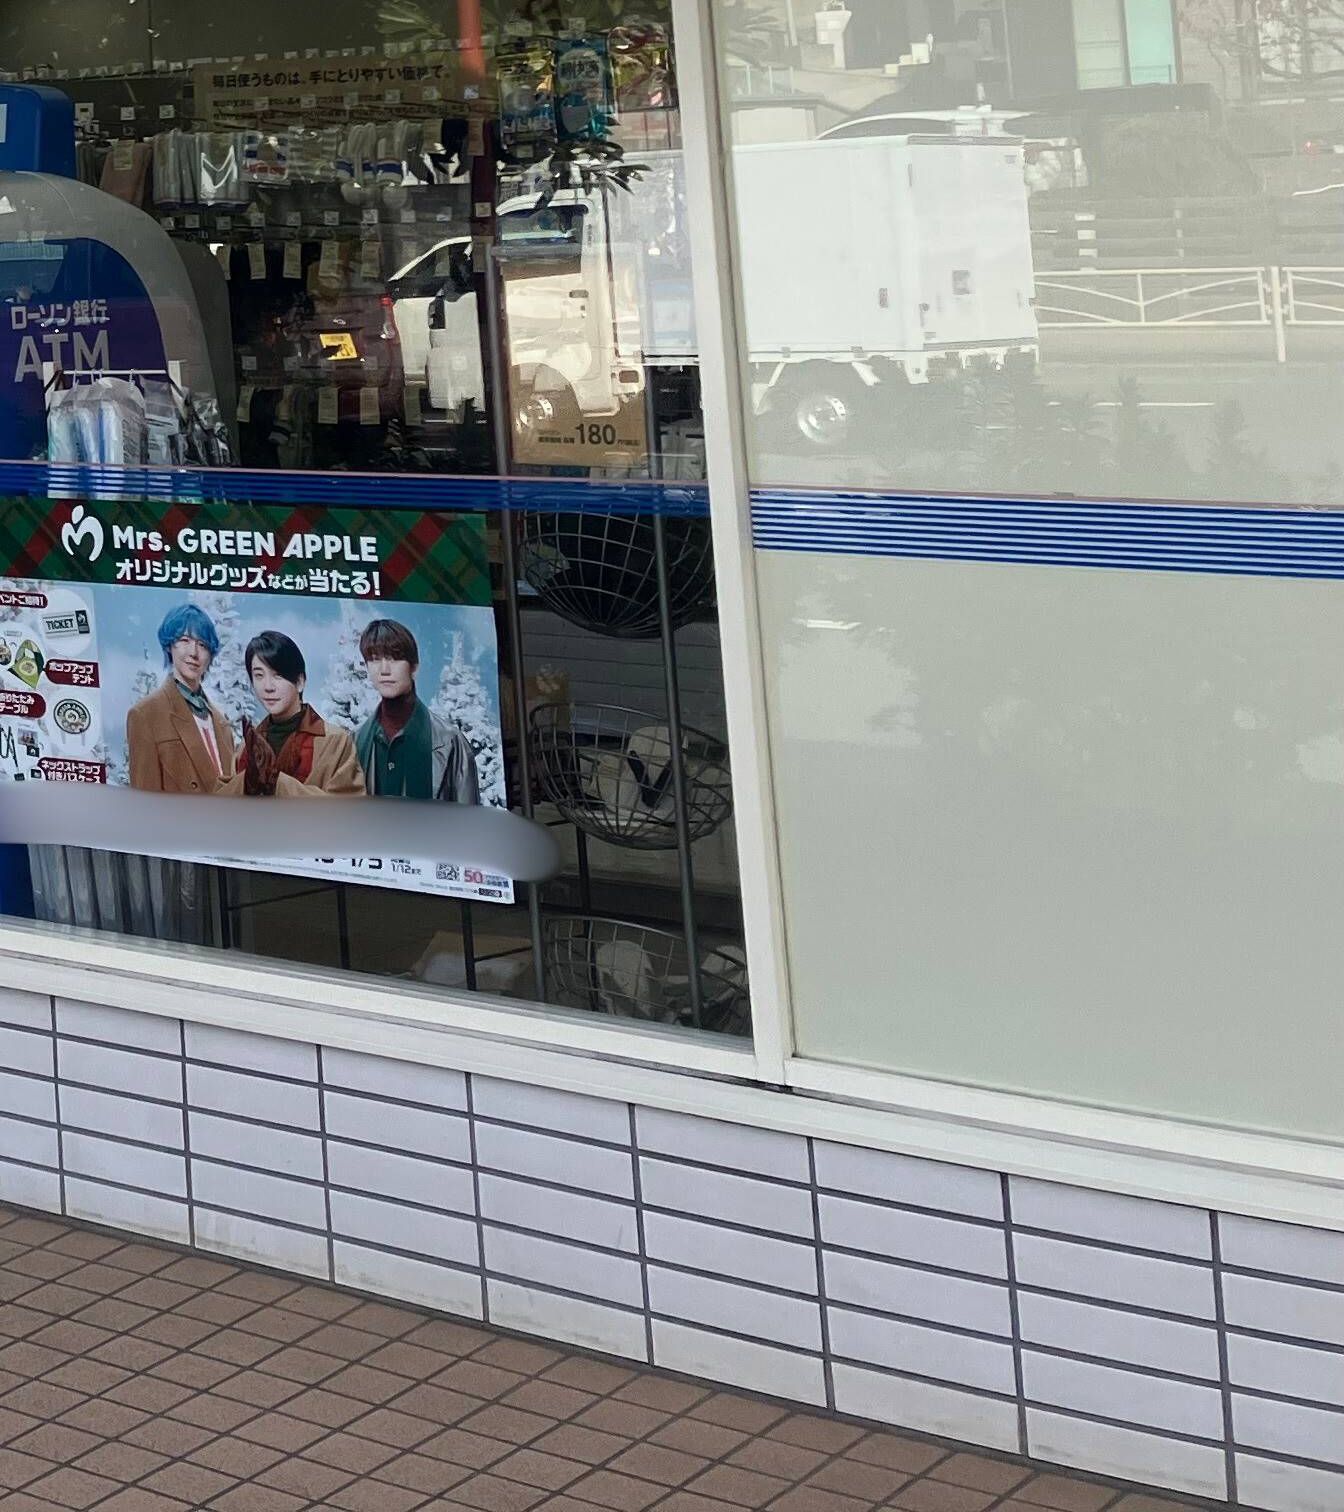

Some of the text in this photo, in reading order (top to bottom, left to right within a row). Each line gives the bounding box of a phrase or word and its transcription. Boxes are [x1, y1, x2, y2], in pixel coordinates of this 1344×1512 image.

[10, 298, 112, 331] ローソン銀行
[14, 329, 111, 383] ATM
[575, 423, 616, 446] 180
[112, 525, 380, 563] Mrs. GREEN APPLE
[115, 561, 382, 597] オリジナルグッズなどが当たる!
[46, 619, 74, 631] TICKET
[71, 673, 95, 685] テント
[41, 759, 101, 776] ネックストラップ
[464, 869, 484, 884] 50
